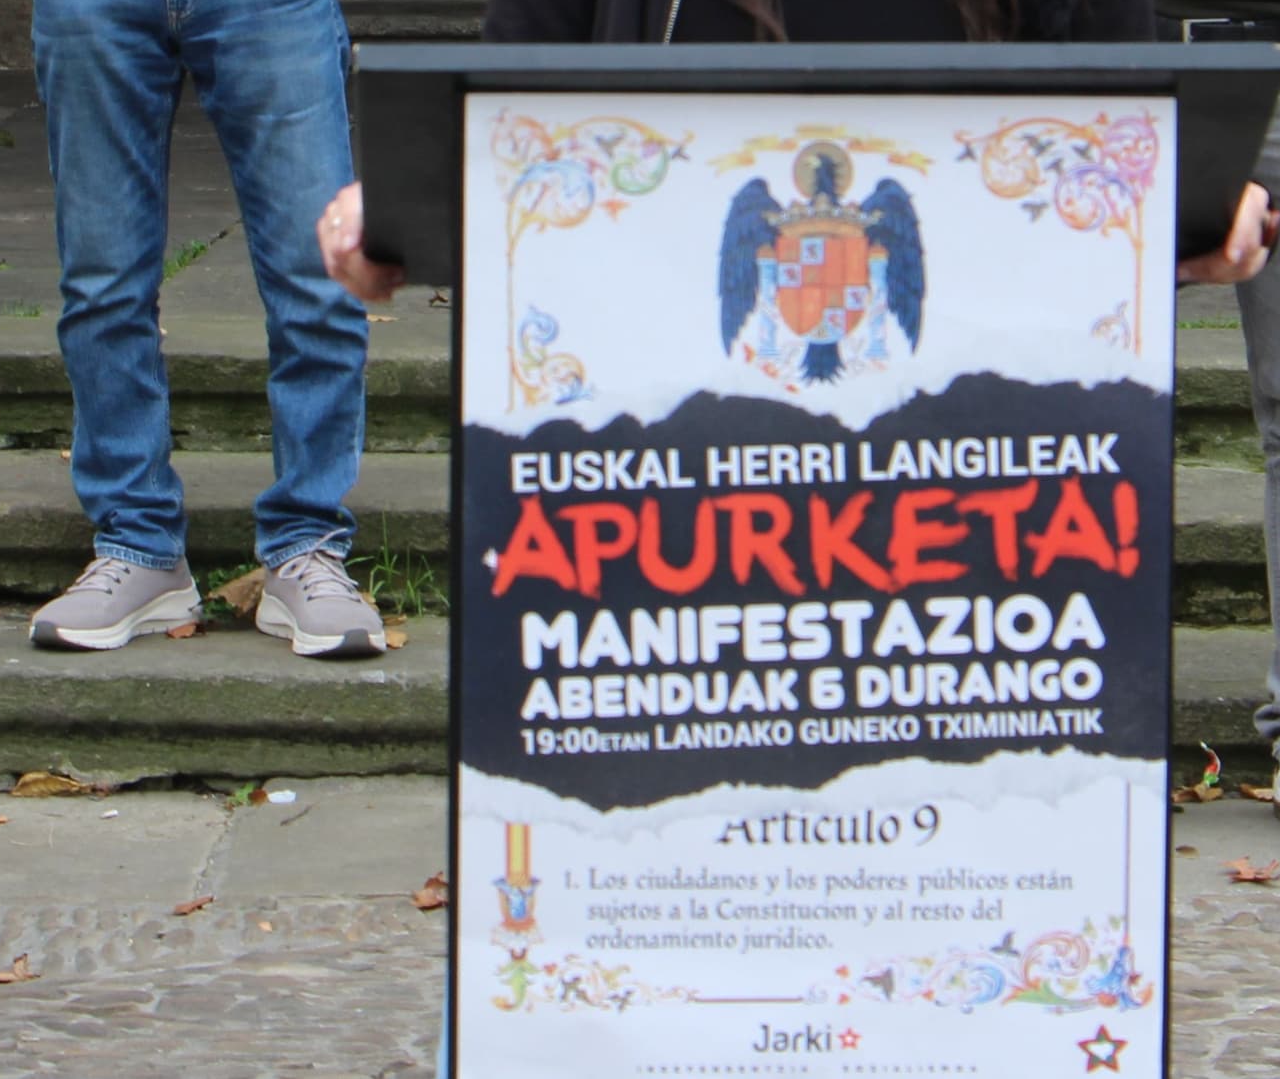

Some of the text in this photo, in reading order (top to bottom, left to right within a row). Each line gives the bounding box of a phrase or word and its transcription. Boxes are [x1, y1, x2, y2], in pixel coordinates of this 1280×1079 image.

[512, 433, 1119, 494] EUSKAL HERRI LANGILEAK
[490, 477, 1141, 599] APURKETA!
[521, 593, 1106, 670] MANIFESTAZIOA
[521, 658, 1103, 721] ABENDUAK 6 DURANGO
[654, 718, 794, 751] LANDAKO
[798, 714, 921, 746] GUNEKO
[924, 707, 1104, 740] TXIMINIATIK
[913, 804, 942, 847] 9
[588, 867, 628, 890] Los
[635, 867, 757, 890] ciudadanos
[765, 873, 780, 896] y
[786, 867, 817, 890] los
[824, 867, 908, 896] poderes
[1016, 869, 1073, 890] están
[587, 899, 661, 925] sujetos
[669, 904, 681, 920] a
[690, 898, 709, 920] la
[863, 905, 878, 926] y
[884, 899, 904, 920] al
[911, 902, 965, 920] resto
[971, 898, 1004, 920] del
[586, 926, 738, 950] ordenamiento
[753, 1023, 832, 1053] Jarki
